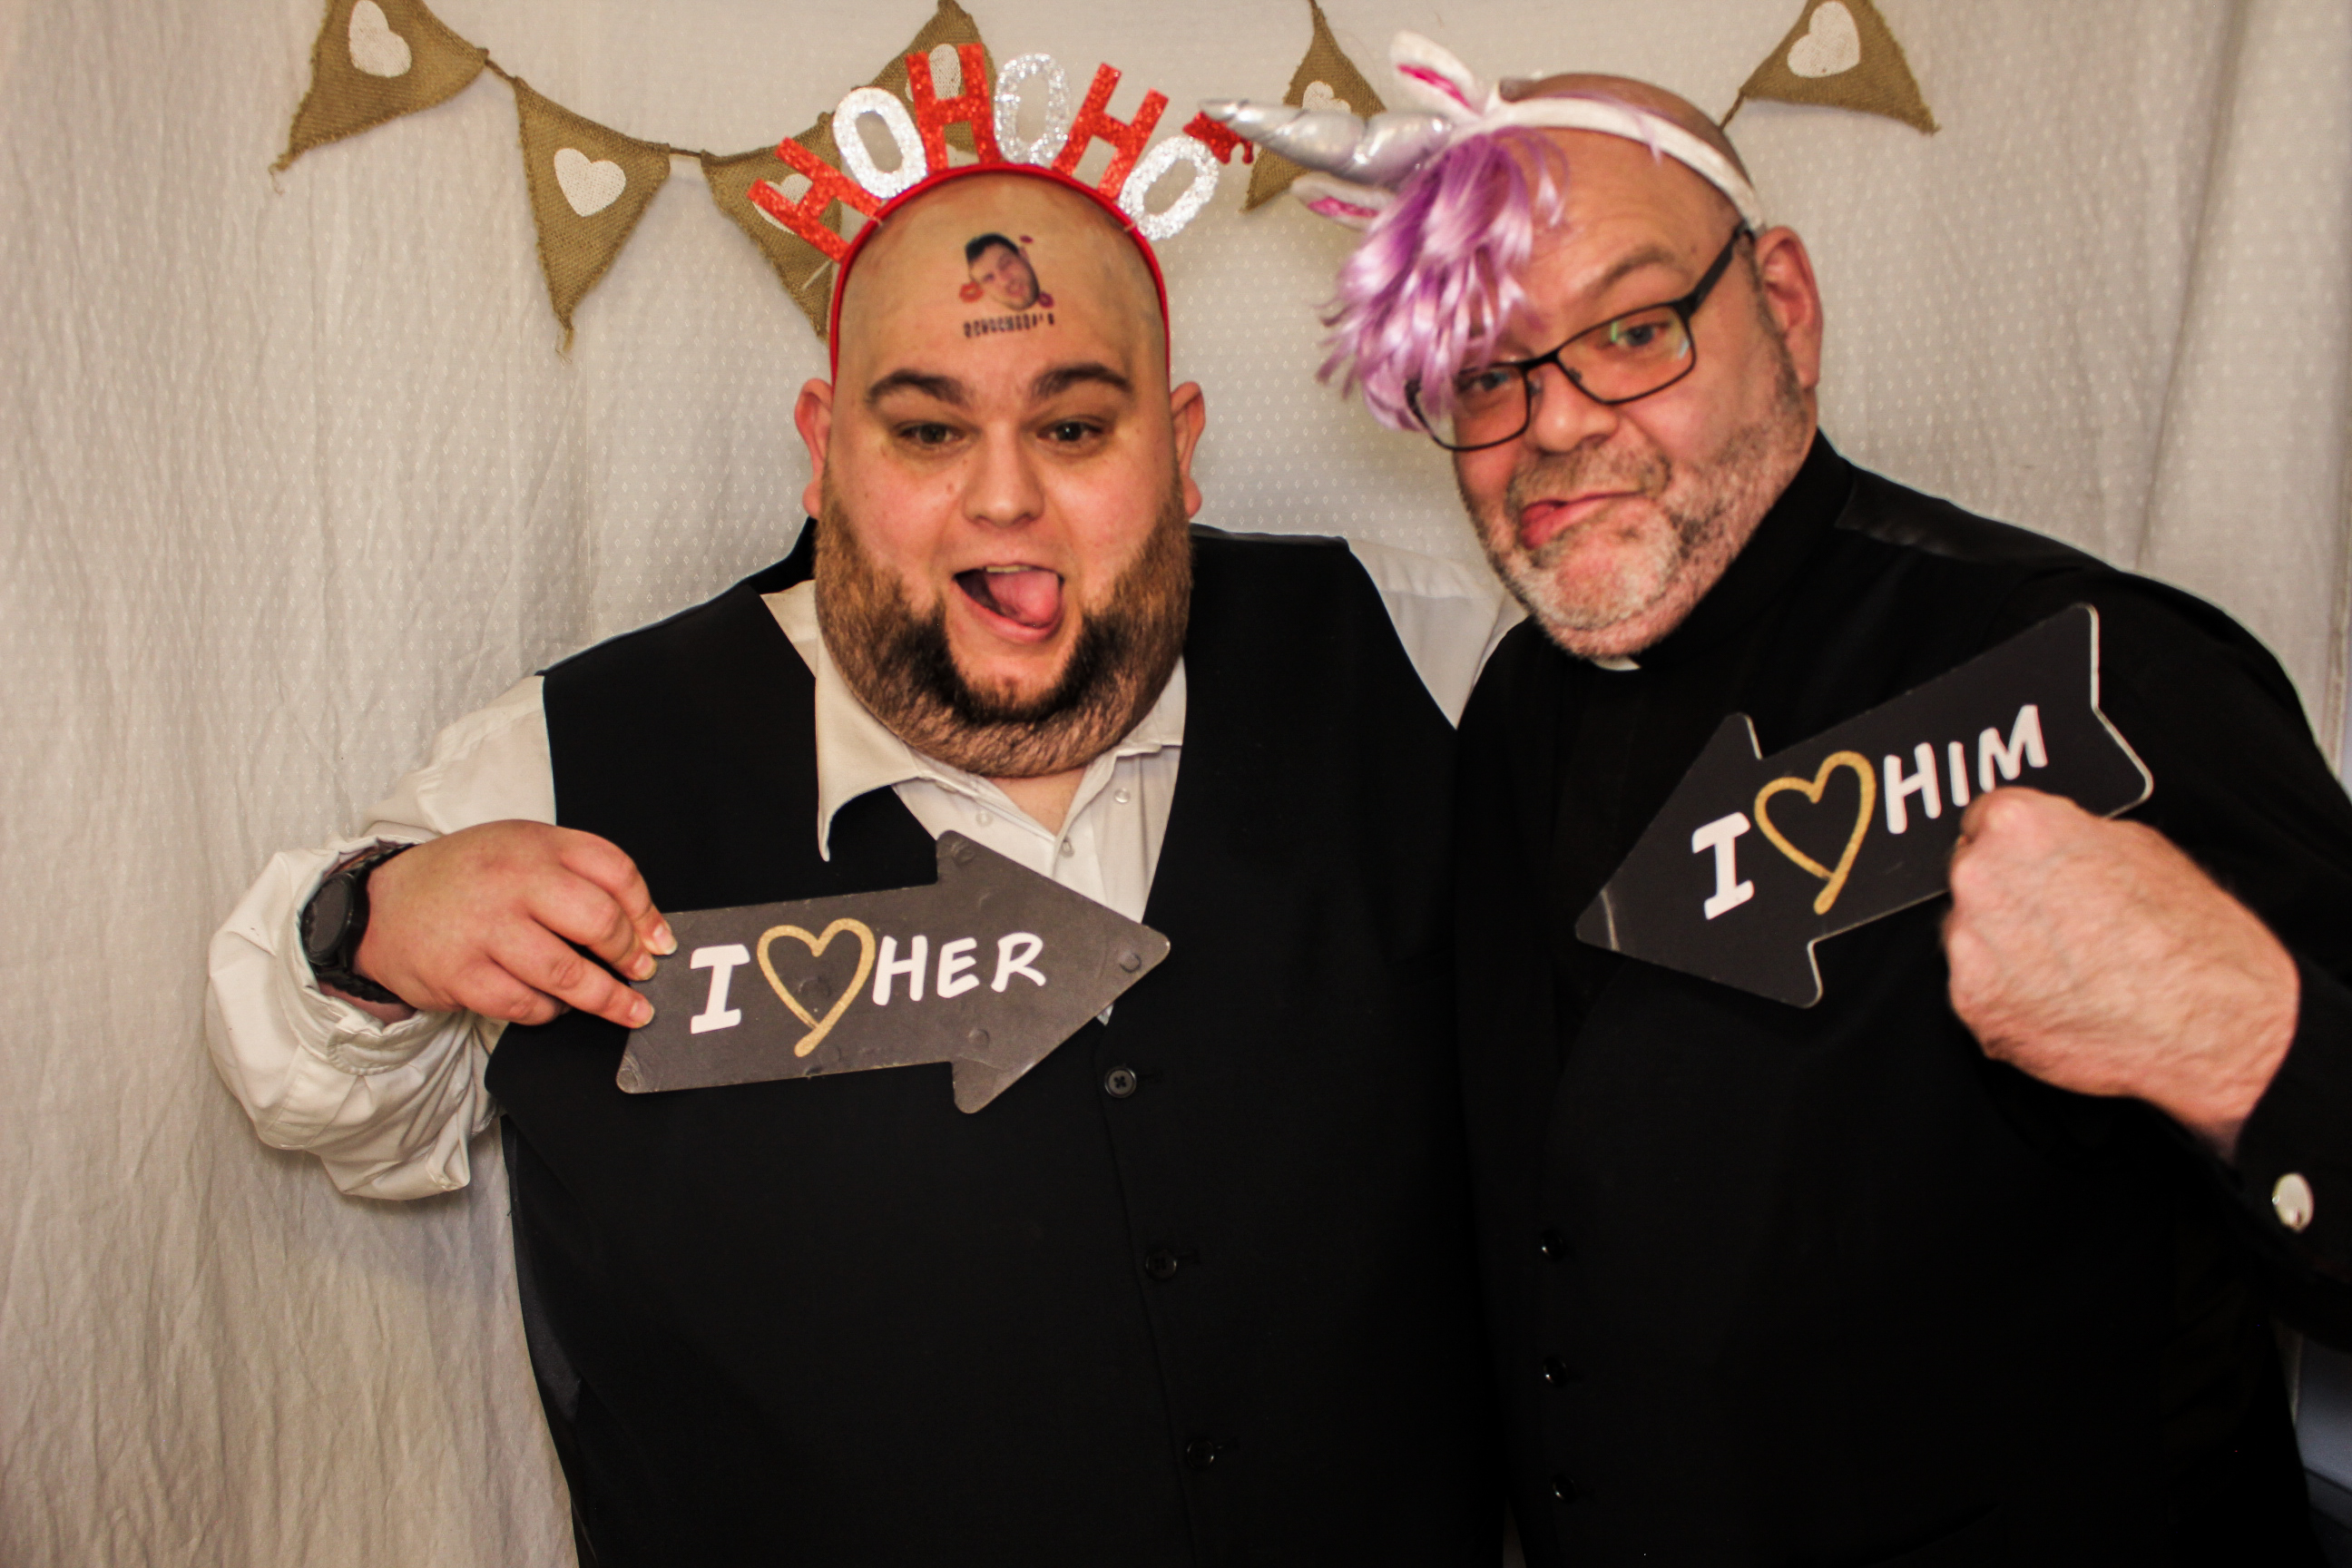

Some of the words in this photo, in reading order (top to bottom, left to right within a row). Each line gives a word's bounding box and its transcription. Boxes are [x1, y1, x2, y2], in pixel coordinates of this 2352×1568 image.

[1691, 812, 1755, 920] I
[1883, 704, 2048, 834] HIM
[690, 944, 751, 1034] I
[872, 932, 1047, 1006] HER
